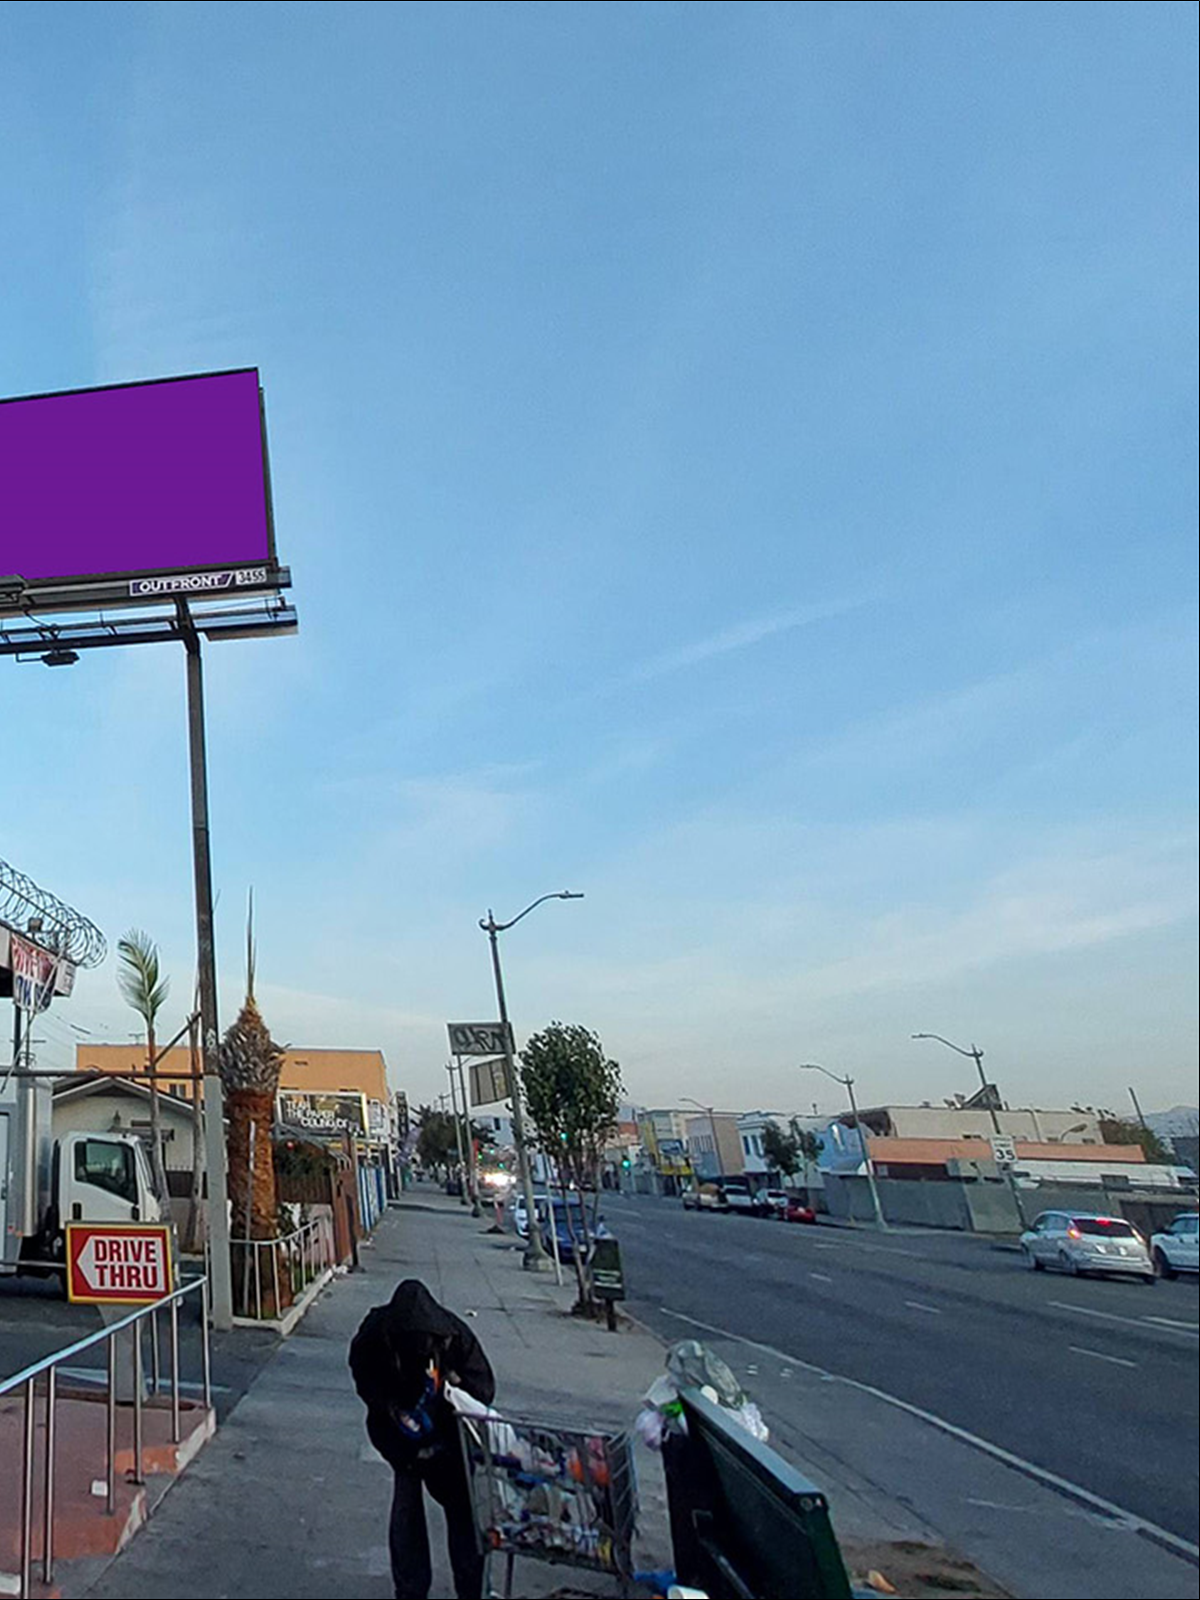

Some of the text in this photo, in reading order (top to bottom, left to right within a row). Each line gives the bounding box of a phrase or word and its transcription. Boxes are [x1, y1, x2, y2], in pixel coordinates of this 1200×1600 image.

[140, 575, 222, 592] OUTFRONT
[996, 1149, 1015, 1160] 35
[94, 1240, 157, 1263] DRIVE
[94, 1264, 158, 1288] THRU
